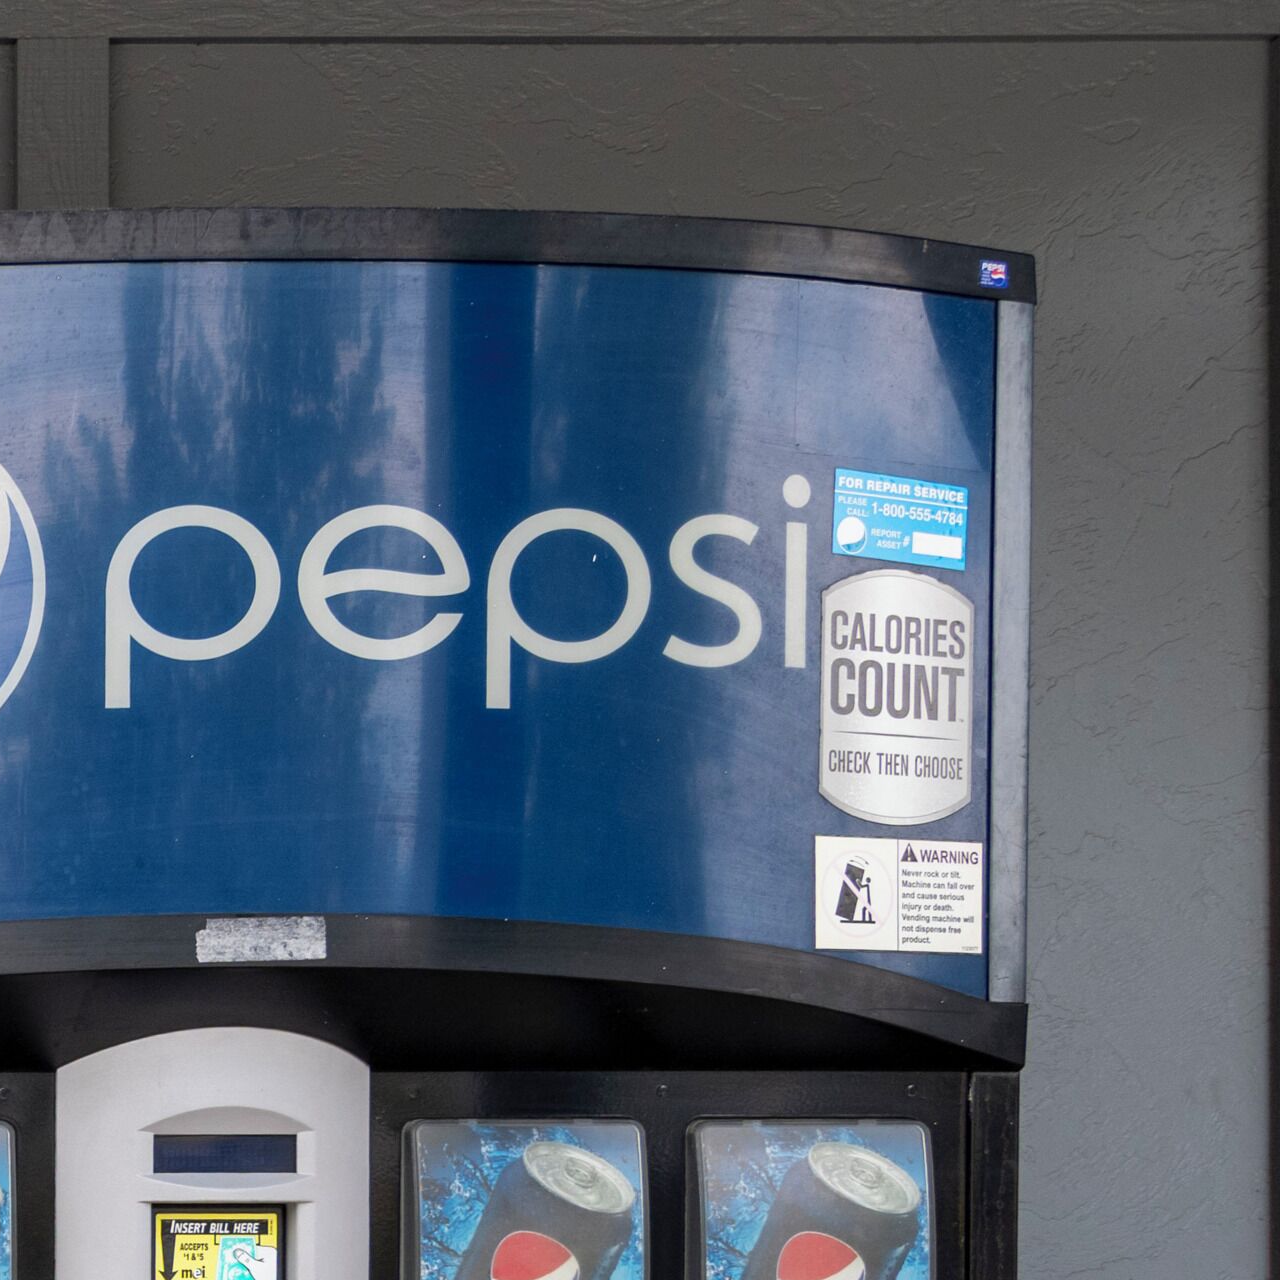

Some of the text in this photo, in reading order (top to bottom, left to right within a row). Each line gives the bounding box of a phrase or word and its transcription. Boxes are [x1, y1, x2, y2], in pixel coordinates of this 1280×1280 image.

[838, 476, 965, 503] FOR REPAIR SERVICE
[838, 495, 867, 506] PLEASE
[871, 502, 963, 526] 1-800-555-4784
[871, 528, 902, 539] REPORT
[876, 539, 901, 550] ASSET
[105, 474, 811, 710] pepsi
[830, 610, 966, 660] CALORIES
[830, 657, 965, 723] COUNT
[828, 749, 963, 780] CHECK THEN CHOOSE
[920, 849, 979, 865] WARNING
[902, 869, 922, 877] Never
[924, 870, 939, 878] rock
[902, 880, 931, 888] Machine
[947, 881, 958, 889] fall
[902, 891, 915, 899] and
[939, 893, 965, 901] serious
[902, 903, 922, 912] injury
[902, 914, 930, 923] Vending
[932, 915, 961, 923] machine
[915, 926, 947, 934] dispense
[948, 926, 962, 934] free
[170, 1220, 207, 1234] INSERT
[209, 1222, 230, 1234] BILL
[233, 1222, 260, 1234] HERE
[180, 1243, 209, 1251] ACCEPTS
[181, 1266, 206, 1280] mei
